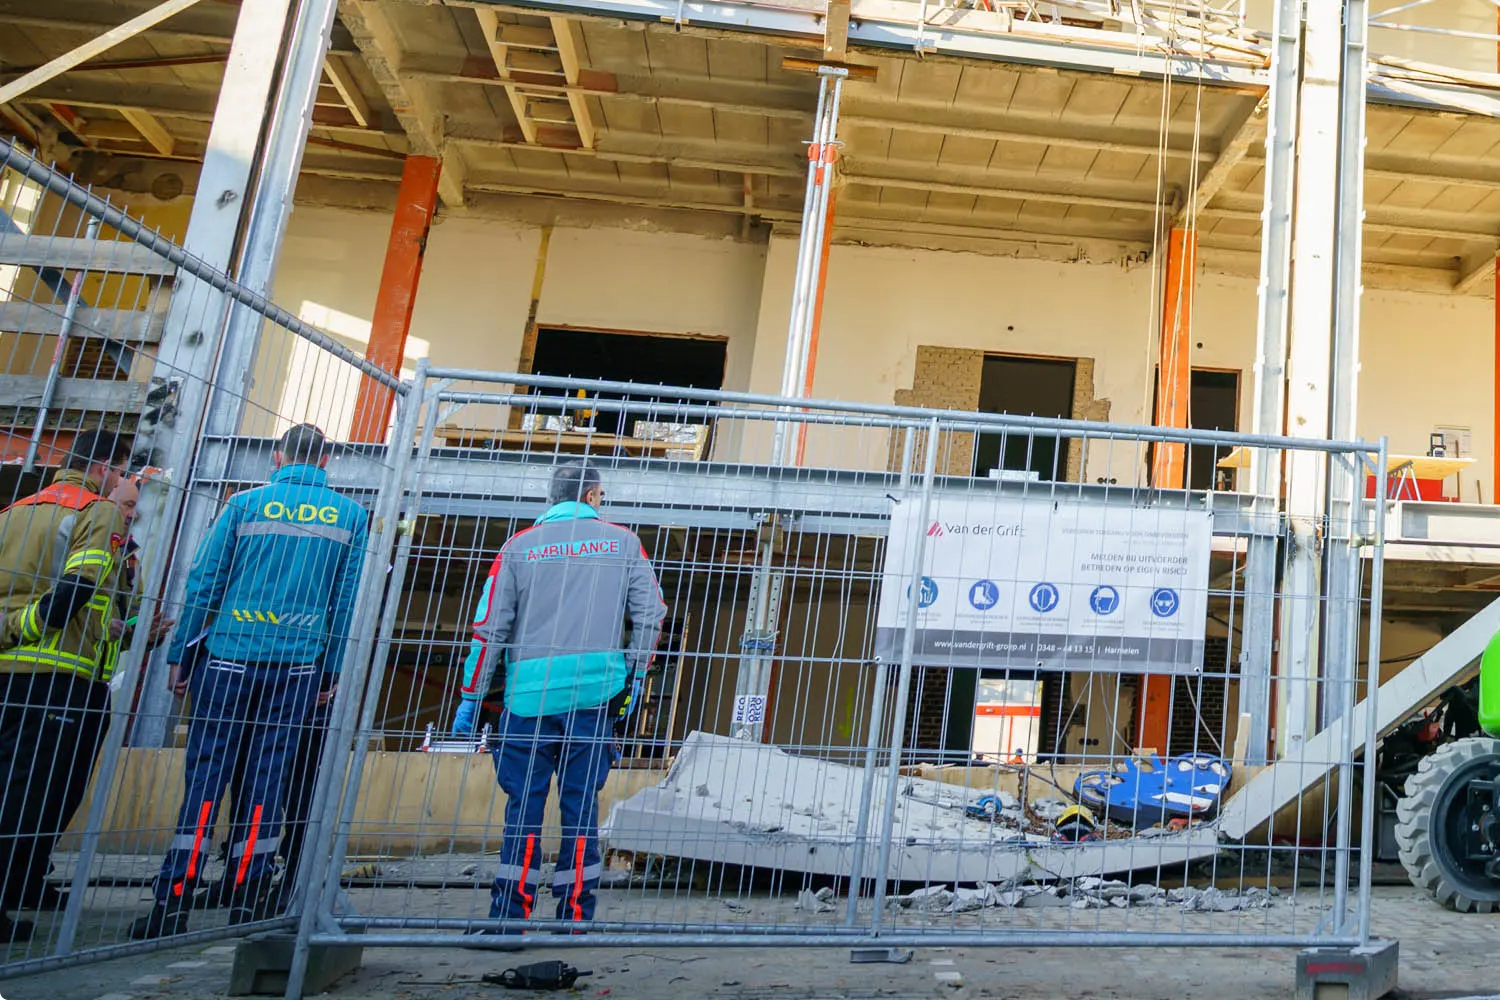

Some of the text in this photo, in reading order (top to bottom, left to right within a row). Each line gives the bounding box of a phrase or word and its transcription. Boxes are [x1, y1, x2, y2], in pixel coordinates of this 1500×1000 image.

[264, 501, 338, 523] OvDG
[945, 522, 969, 535] Van
[972, 524, 992, 535] der
[528, 540, 618, 561] AMBULANCE
[737, 697, 745, 721] RECO
